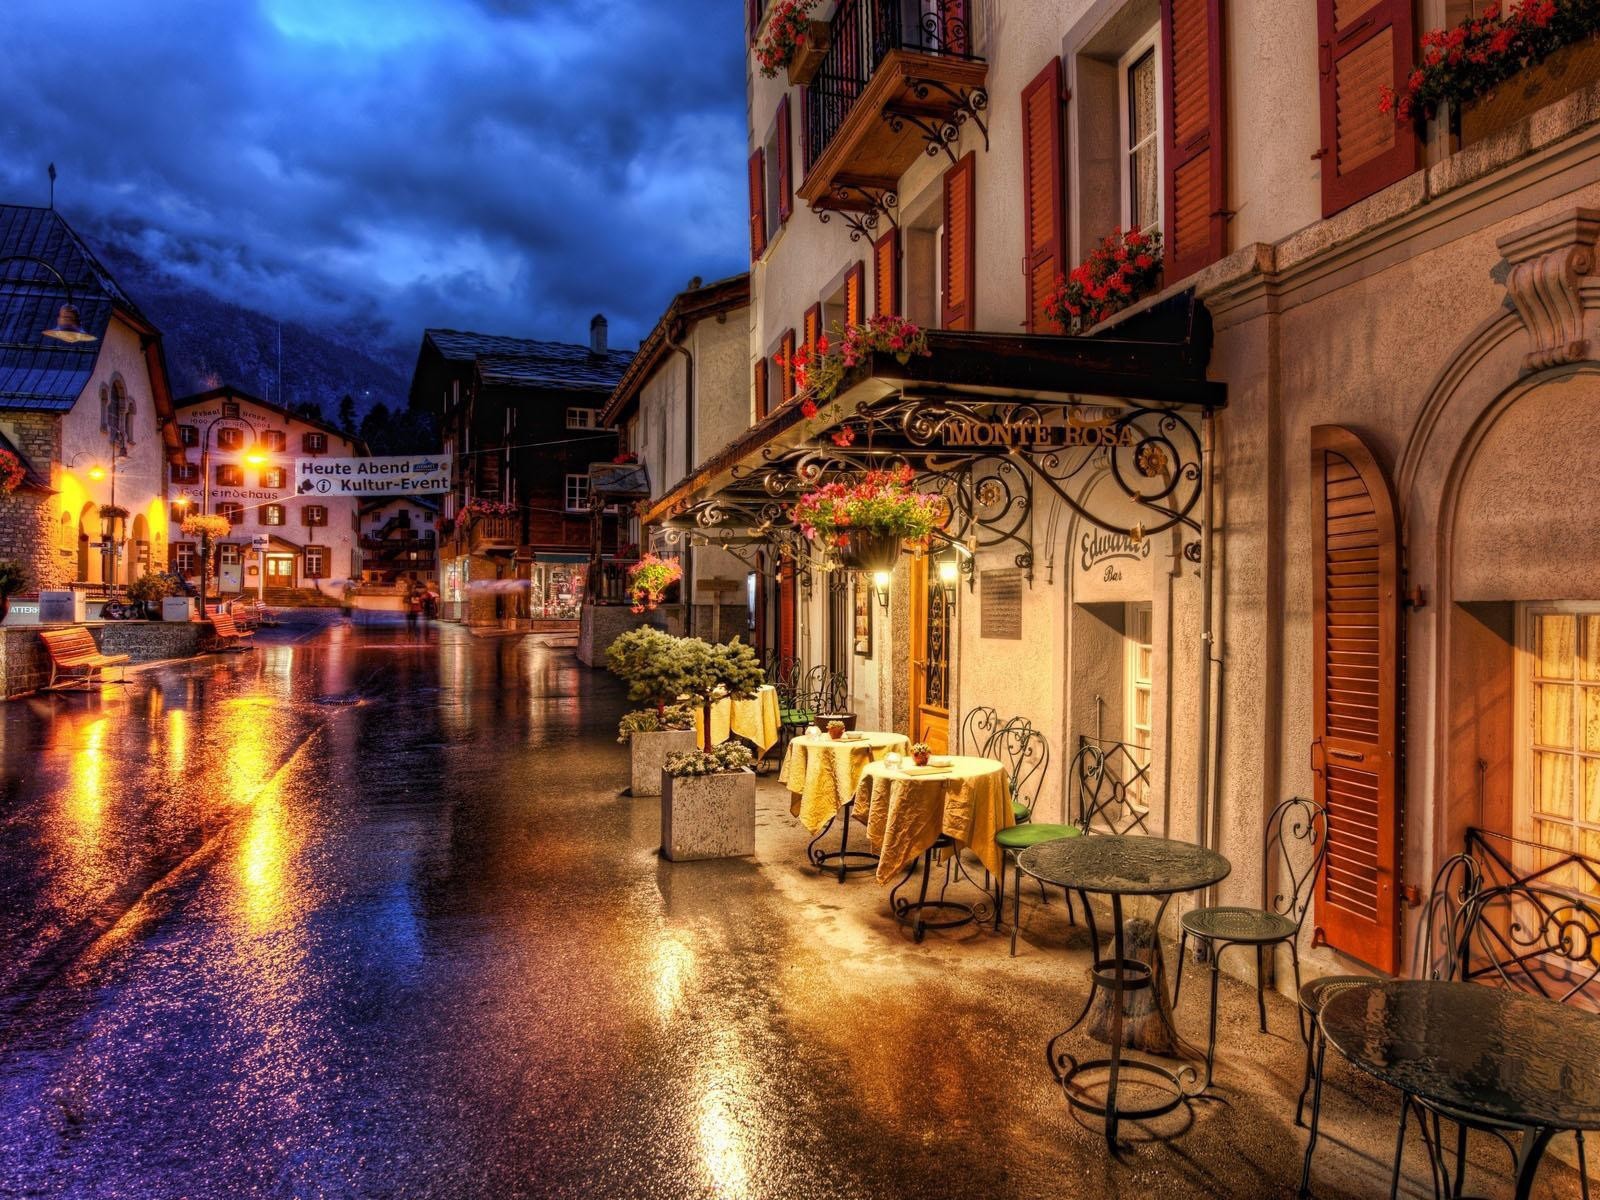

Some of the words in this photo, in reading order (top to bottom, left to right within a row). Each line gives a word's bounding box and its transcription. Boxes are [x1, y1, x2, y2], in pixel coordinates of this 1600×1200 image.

[946, 422, 1051, 446] MONTE
[1063, 424, 1134, 447] ROSA
[301, 462, 351, 475] Heute
[357, 461, 410, 475] Abend
[341, 477, 449, 492] Kultur-Event
[1081, 527, 1151, 571] Edwars
[1103, 565, 1123, 583] Bar
